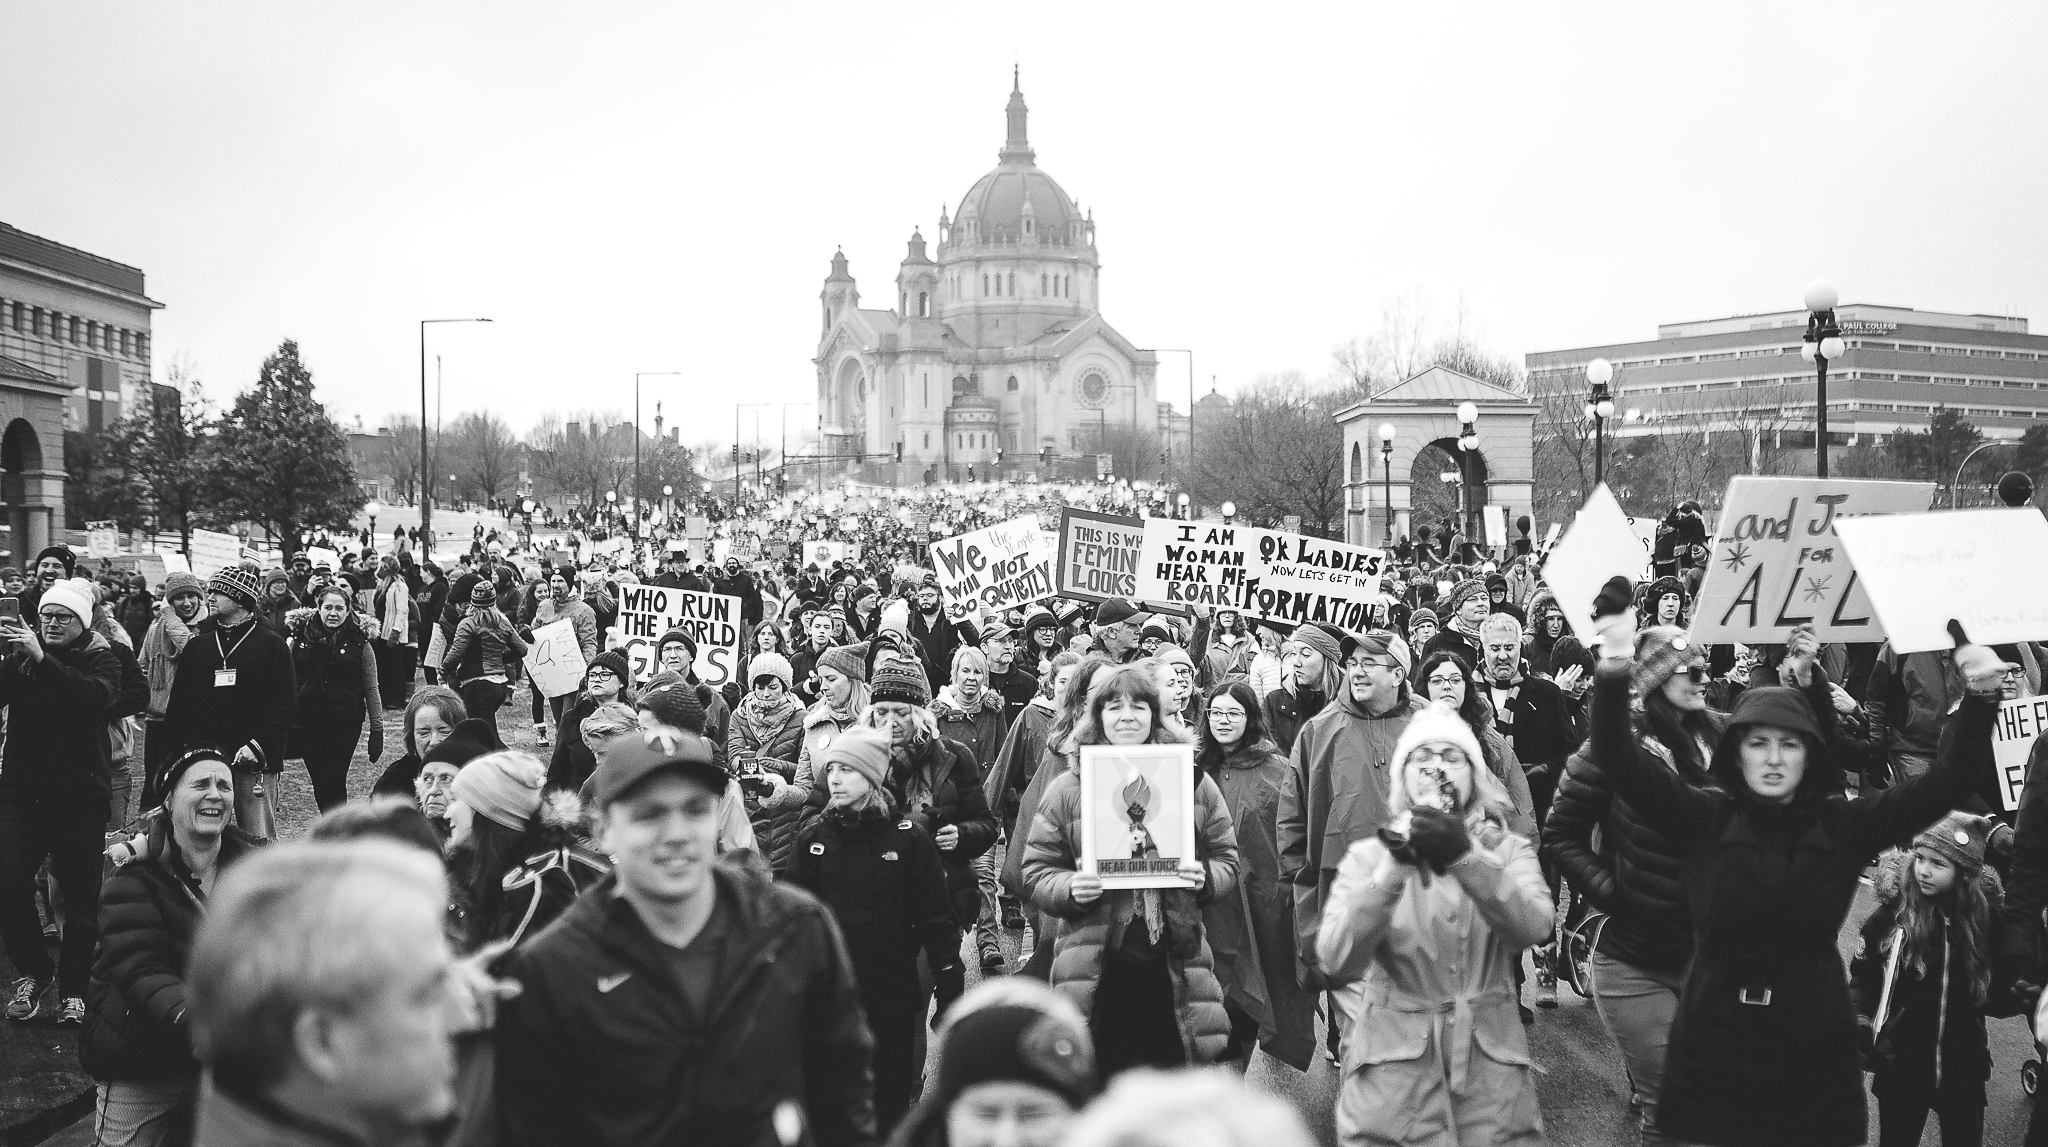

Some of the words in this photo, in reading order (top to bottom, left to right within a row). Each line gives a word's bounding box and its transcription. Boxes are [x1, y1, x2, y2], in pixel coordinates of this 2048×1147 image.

[1843, 322, 1864, 330] PAUL
[1074, 526, 1102, 542] THIS
[1107, 531, 1120, 545] IS
[1123, 533, 1143, 549] WH
[1177, 525, 1197, 542] I
[1204, 528, 1235, 546] AM
[936, 539, 987, 580] We
[1165, 545, 1244, 566] WOMAN
[1296, 538, 1383, 576] LADIES
[1798, 548, 1834, 565] FOR
[1072, 564, 1136, 596] LOOKS
[1156, 563, 1208, 583] HEAR
[1221, 567, 1246, 586] ME
[1271, 565, 1296, 577] NOW
[1300, 569, 1326, 581] LET'S
[1330, 573, 1351, 585] GET
[1355, 578, 1367, 587] IN
[623, 587, 667, 613] WHO
[681, 594, 729, 622] RUN
[1167, 582, 1240, 607] ROAR!
[1242, 577, 1377, 634] FORMATION
[1720, 561, 1871, 627] ALL
[951, 599, 978, 619] GO
[621, 612, 657, 637] THE
[625, 638, 729, 686] GIS
